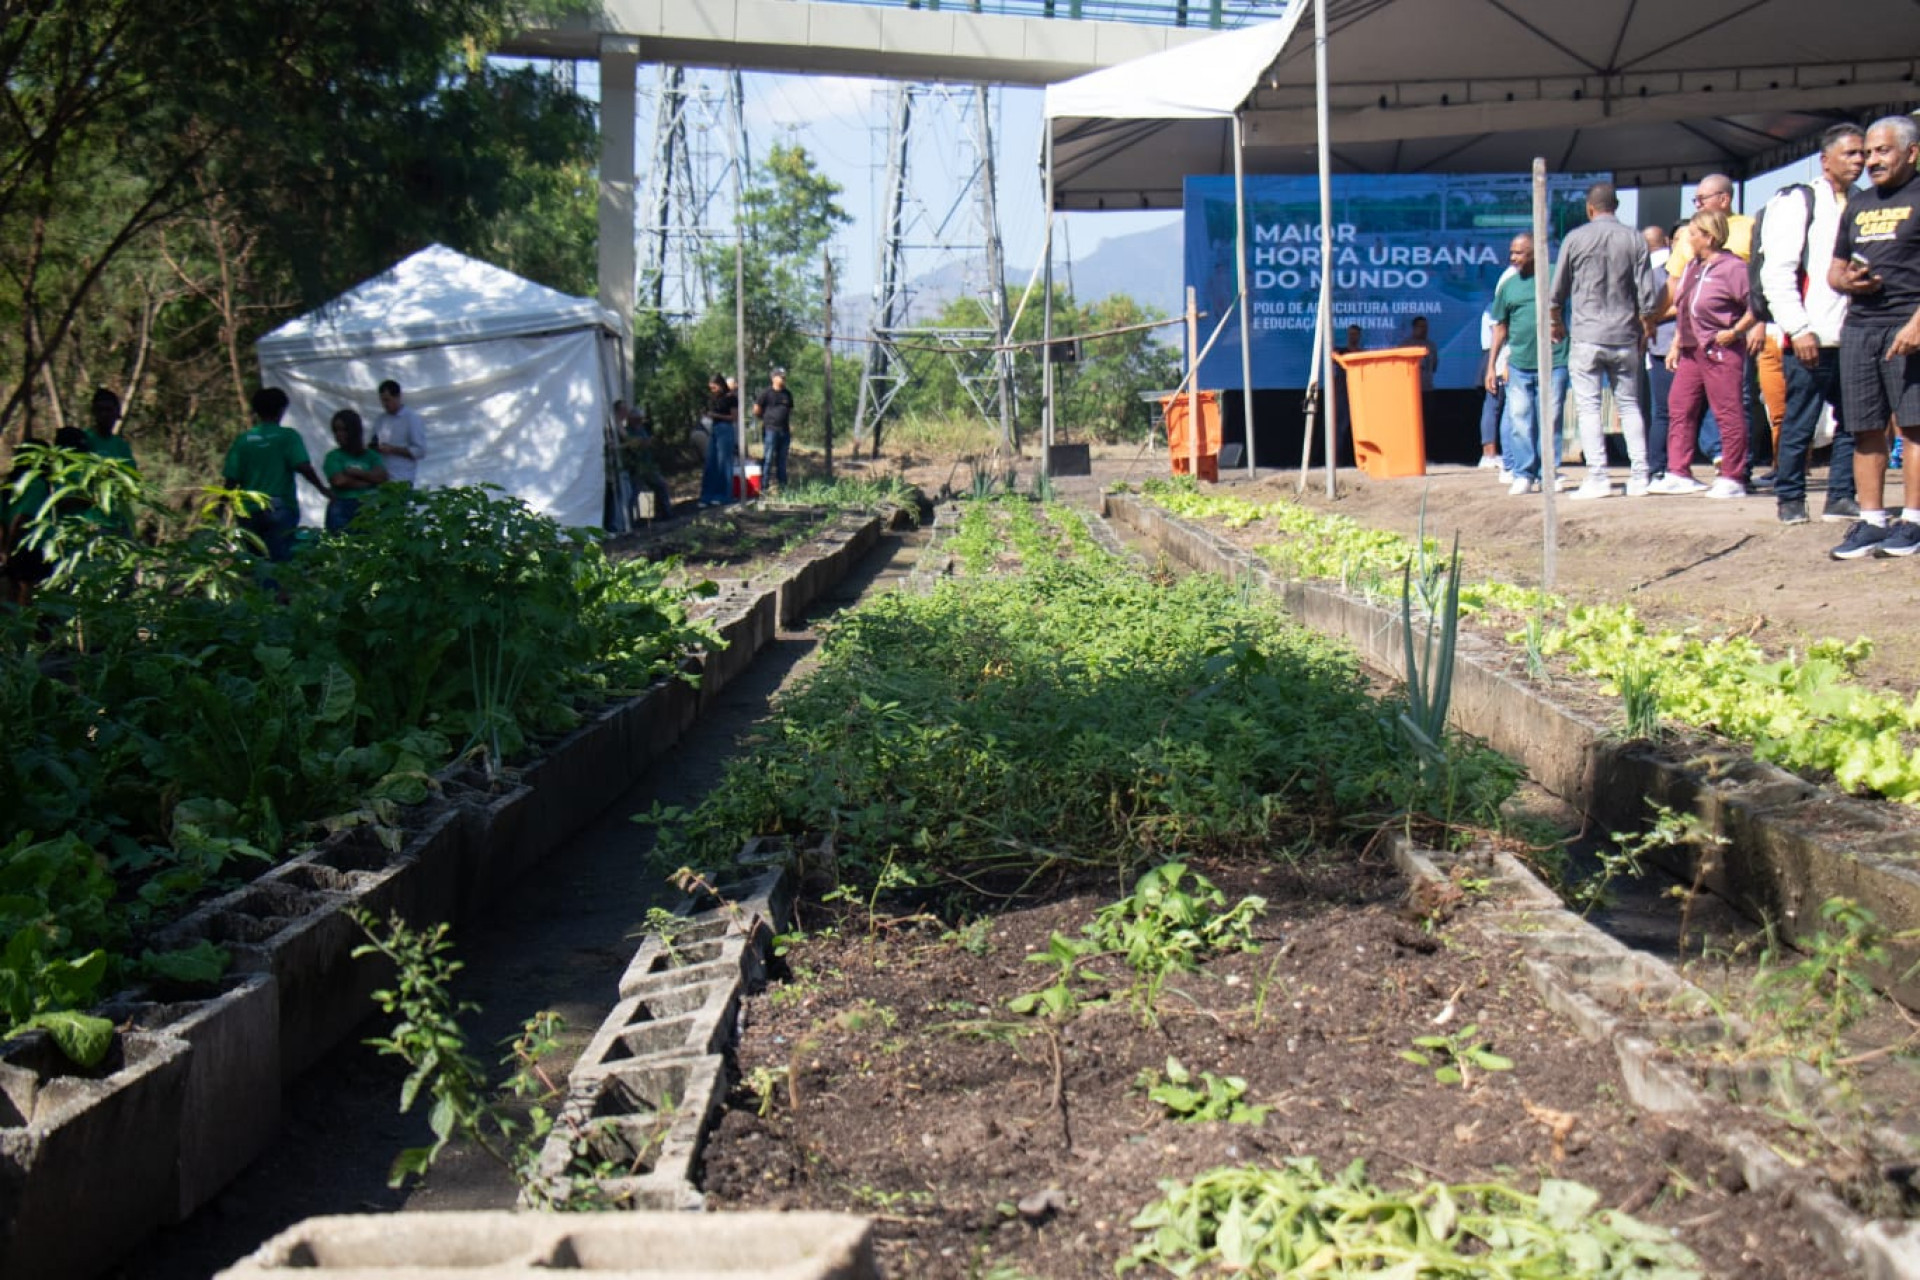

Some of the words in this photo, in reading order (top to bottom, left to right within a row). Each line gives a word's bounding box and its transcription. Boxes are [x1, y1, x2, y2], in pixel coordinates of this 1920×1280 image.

[1255, 223, 1357, 242] MAIOR
[1369, 246, 1499, 265] URBANA
[1255, 269, 1300, 289] DO
[1253, 302, 1285, 314] POLO
[1288, 302, 1303, 314] DE
[1392, 301, 1442, 314] URBANA
[1253, 317, 1260, 329] E
